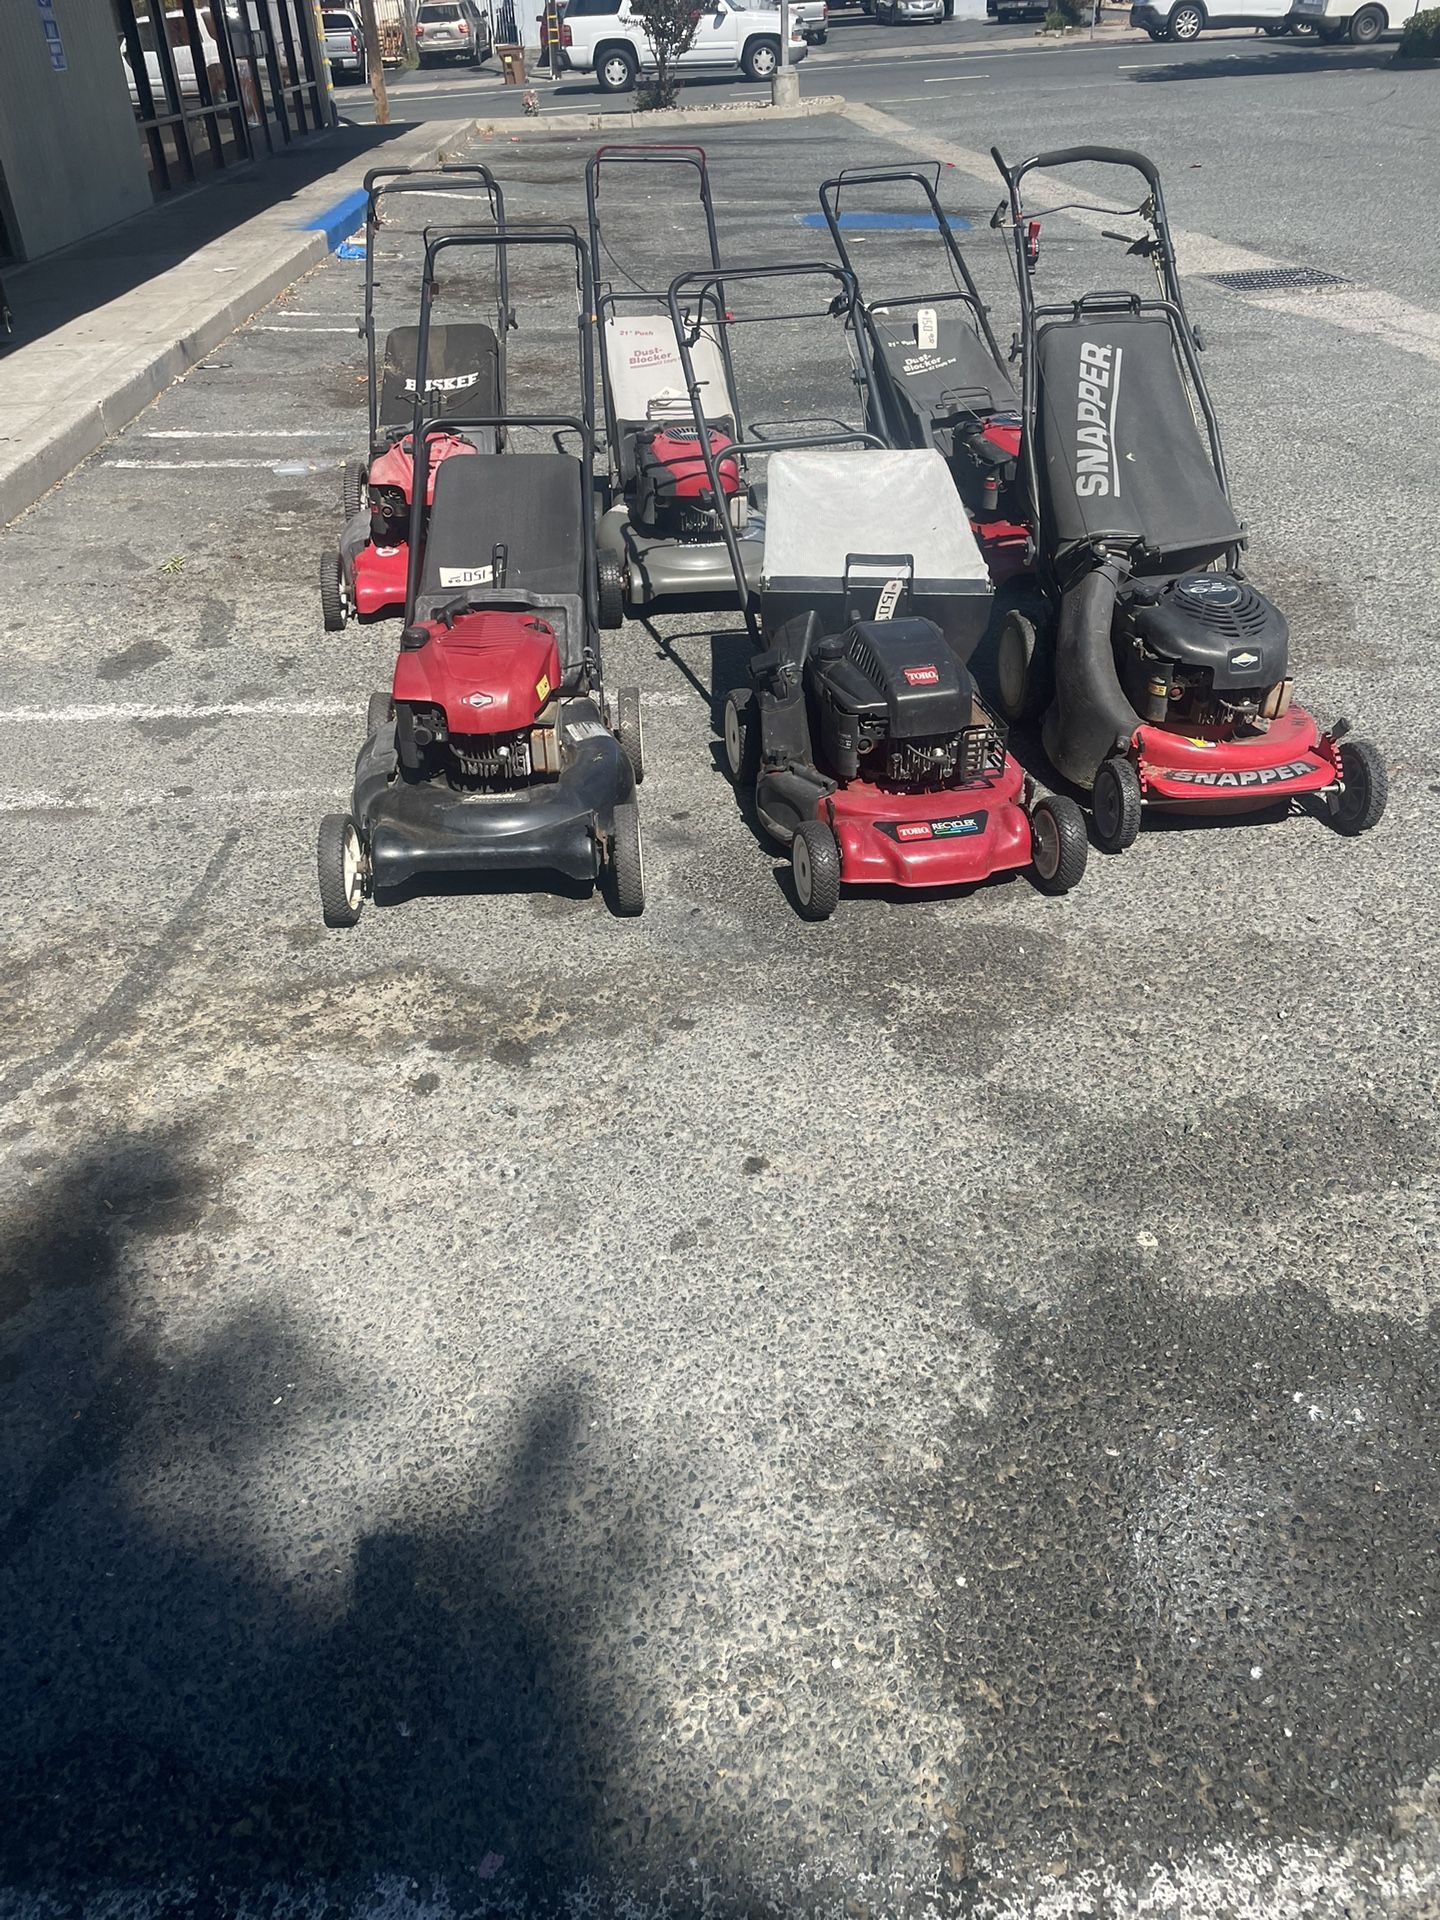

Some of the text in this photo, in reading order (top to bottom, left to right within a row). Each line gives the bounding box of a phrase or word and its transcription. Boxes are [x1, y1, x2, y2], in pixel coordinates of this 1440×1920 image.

[629, 352, 672, 364] Blocker
[633, 347, 663, 357] Dust-
[903, 357, 941, 372] Blocker
[905, 353, 932, 365] Dust-
[1076, 342, 1112, 497] SNAPPER
[908, 670, 936, 680] TORO
[1172, 761, 1312, 786] SNAPPER
[900, 819, 977, 836] TORO RECYCLER
